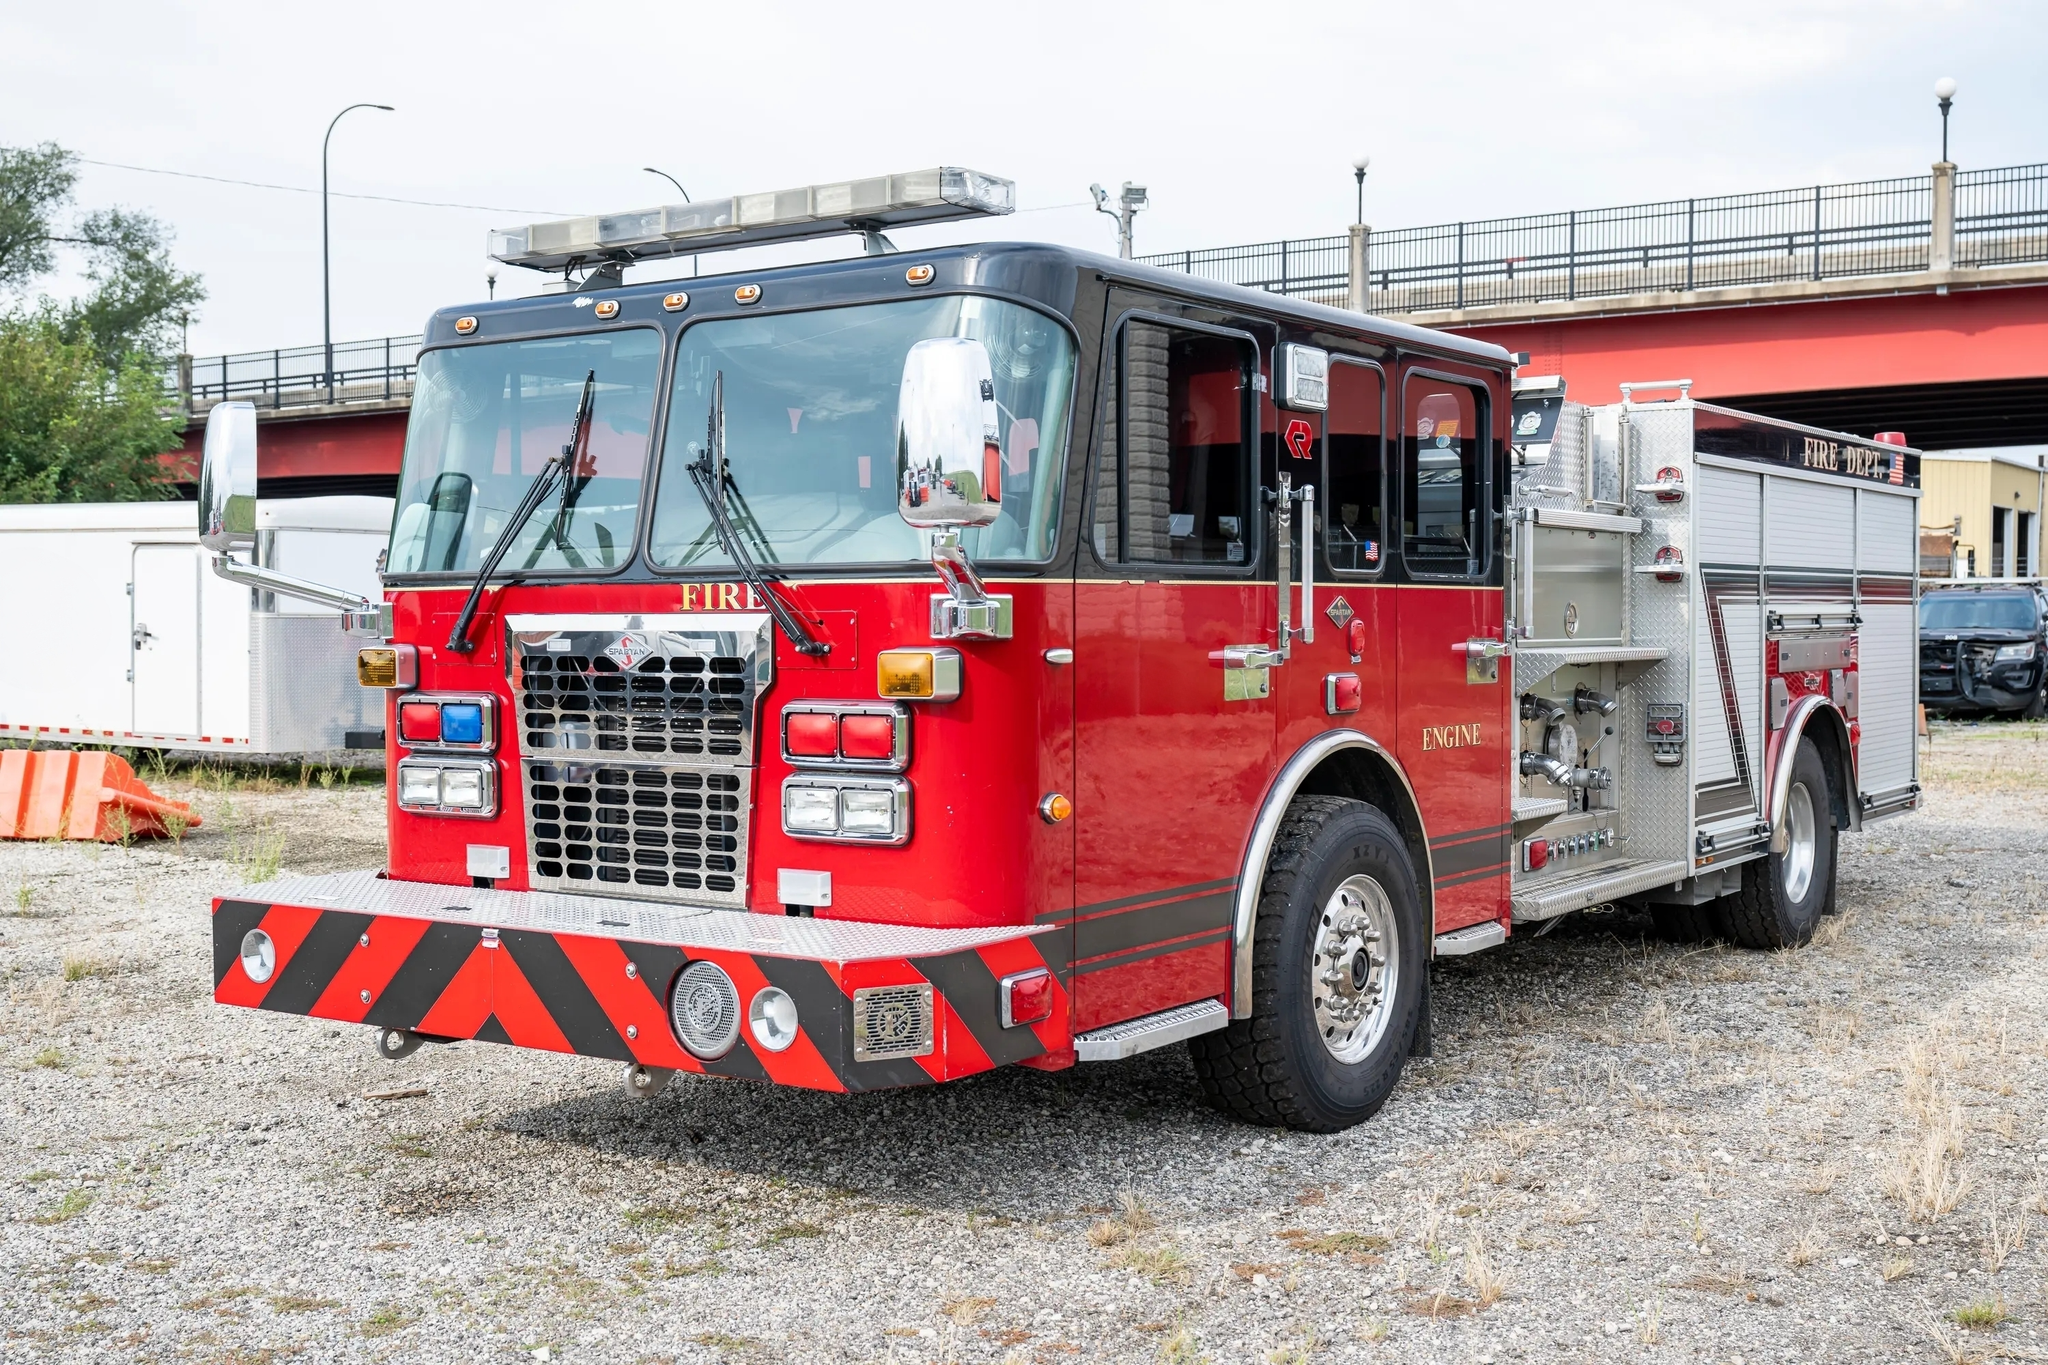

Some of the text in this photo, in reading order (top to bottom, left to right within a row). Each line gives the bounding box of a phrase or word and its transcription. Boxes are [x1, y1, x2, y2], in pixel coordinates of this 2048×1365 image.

[1803, 436, 1883, 479] FIRE DEPT.
[680, 582, 769, 611] FIRE
[1330, 608, 1352, 616] SPARTAN
[608, 647, 646, 656] SPARTAN
[1422, 723, 1482, 752] ENGINE
